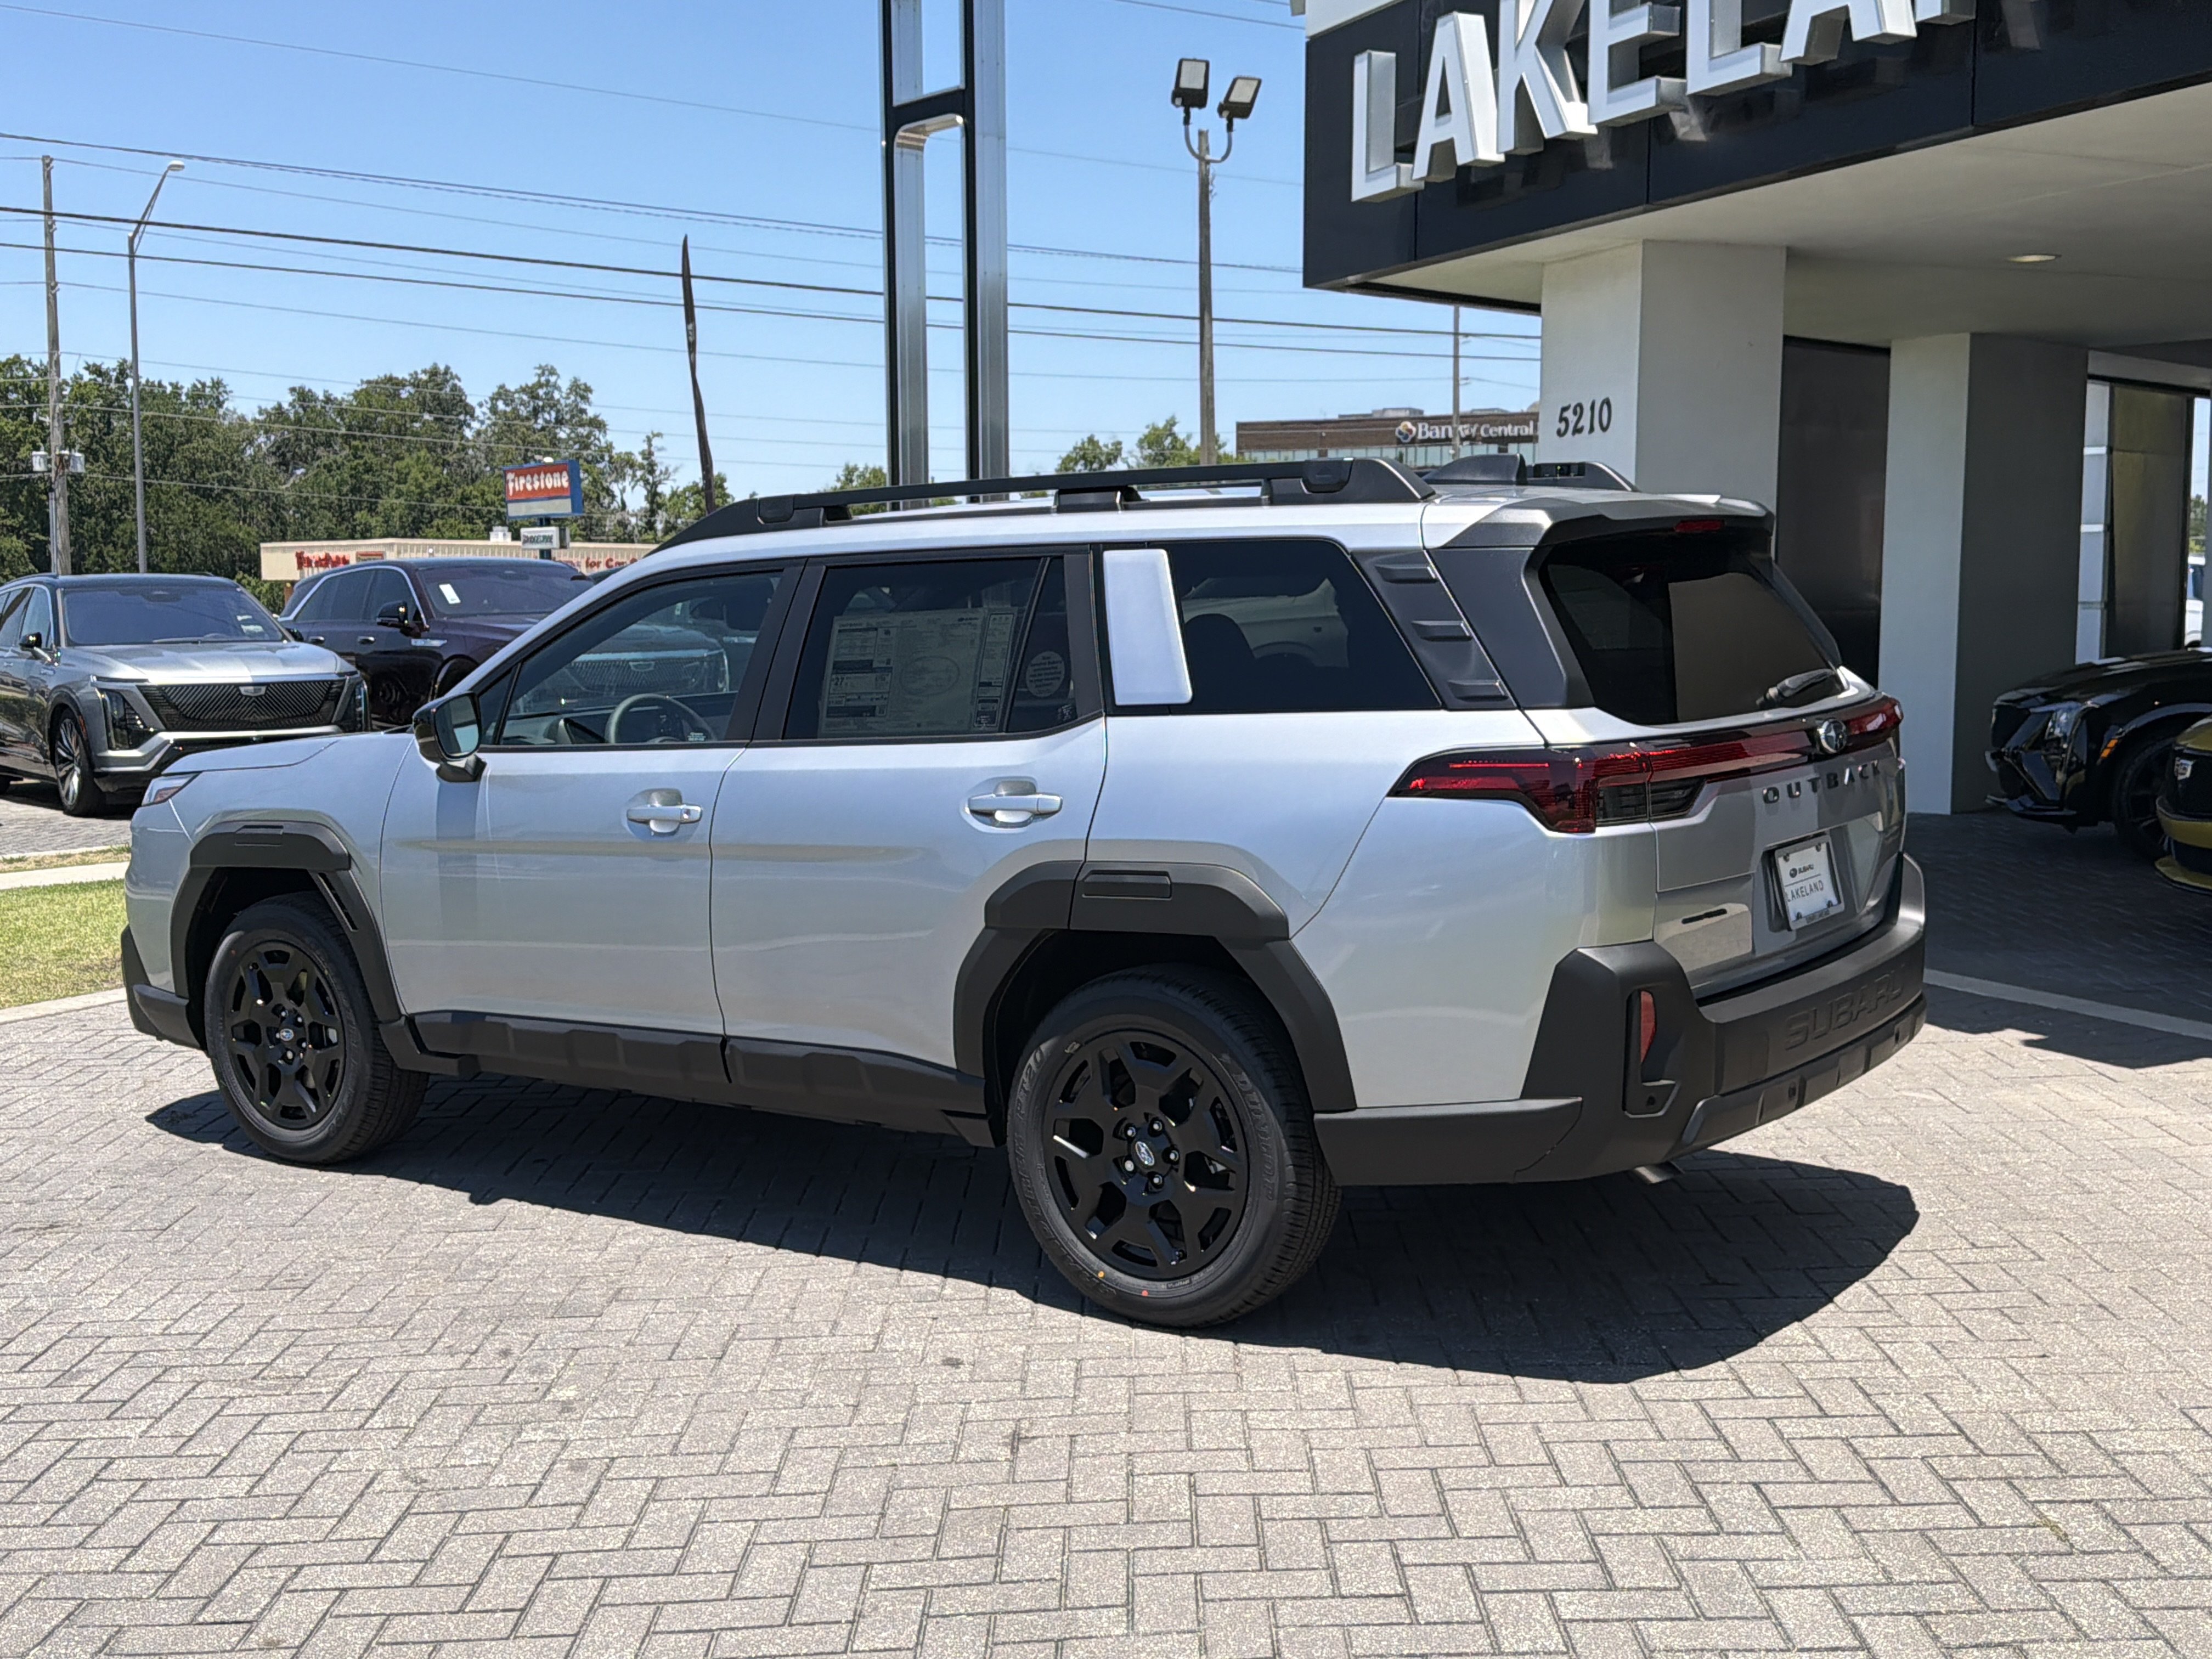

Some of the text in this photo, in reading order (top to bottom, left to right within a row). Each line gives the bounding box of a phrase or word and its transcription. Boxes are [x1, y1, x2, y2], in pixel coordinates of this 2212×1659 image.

[1481, 420, 1533, 437] Central
[1556, 397, 1612, 438] 5210
[506, 471, 569, 496] Firestone
[1762, 760, 1880, 804] OUTBACK
[1785, 964, 1905, 1051] SUBARU
